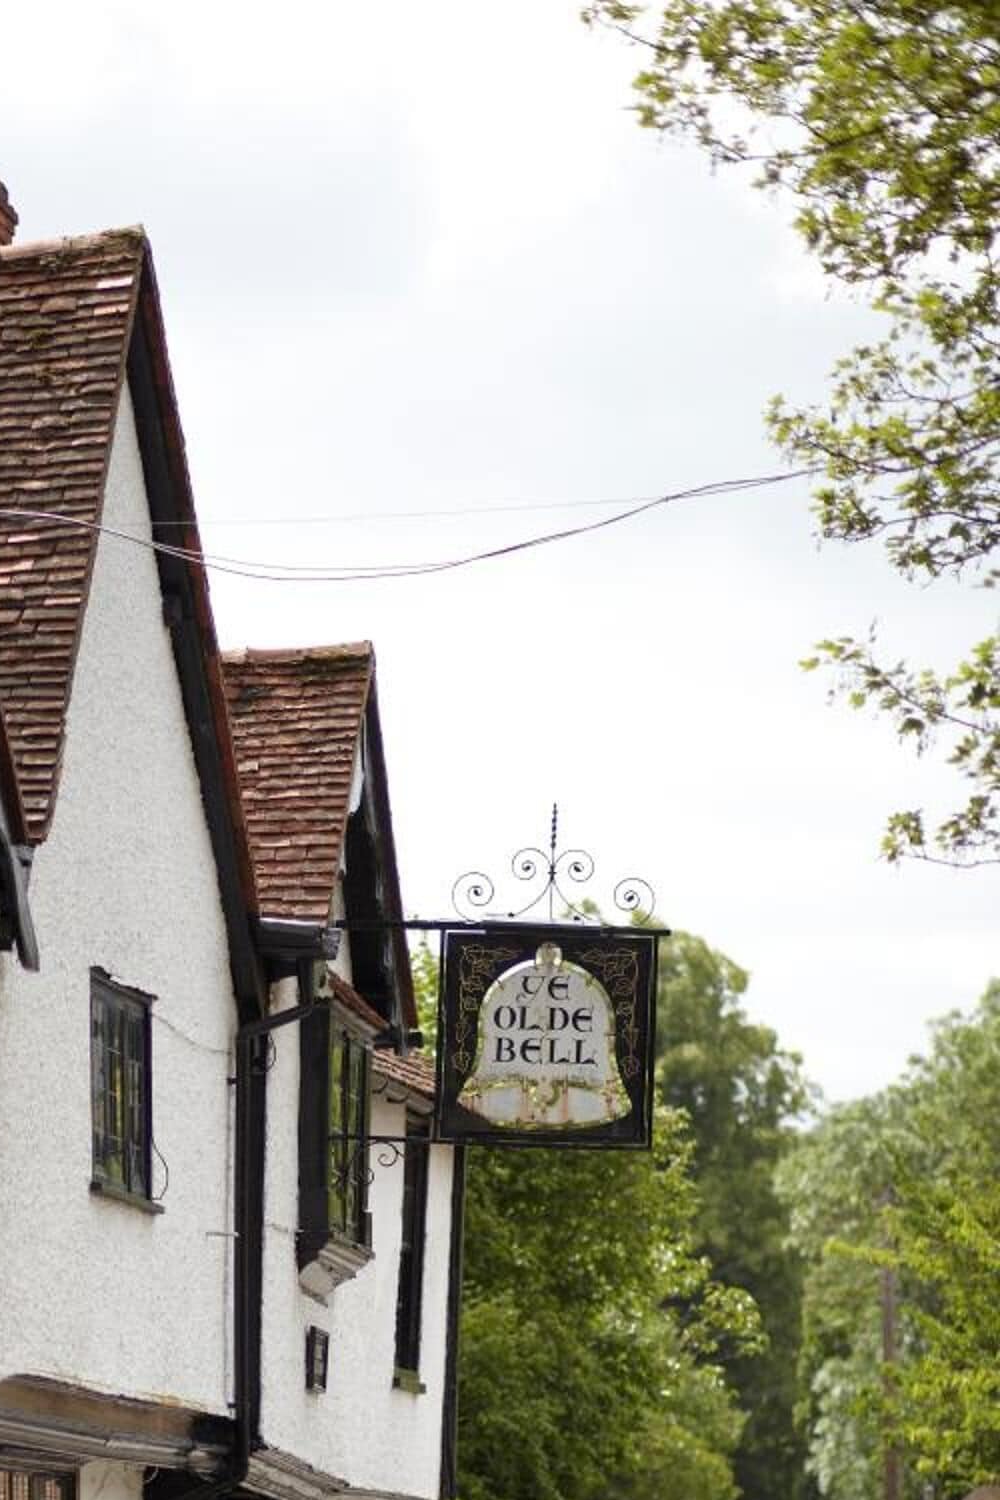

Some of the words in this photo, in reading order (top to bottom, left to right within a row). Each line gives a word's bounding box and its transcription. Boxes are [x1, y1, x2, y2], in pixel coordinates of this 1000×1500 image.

[516, 975, 569, 1002] YE
[494, 1005, 593, 1032] OLDE
[493, 1036, 598, 1066] BELL
